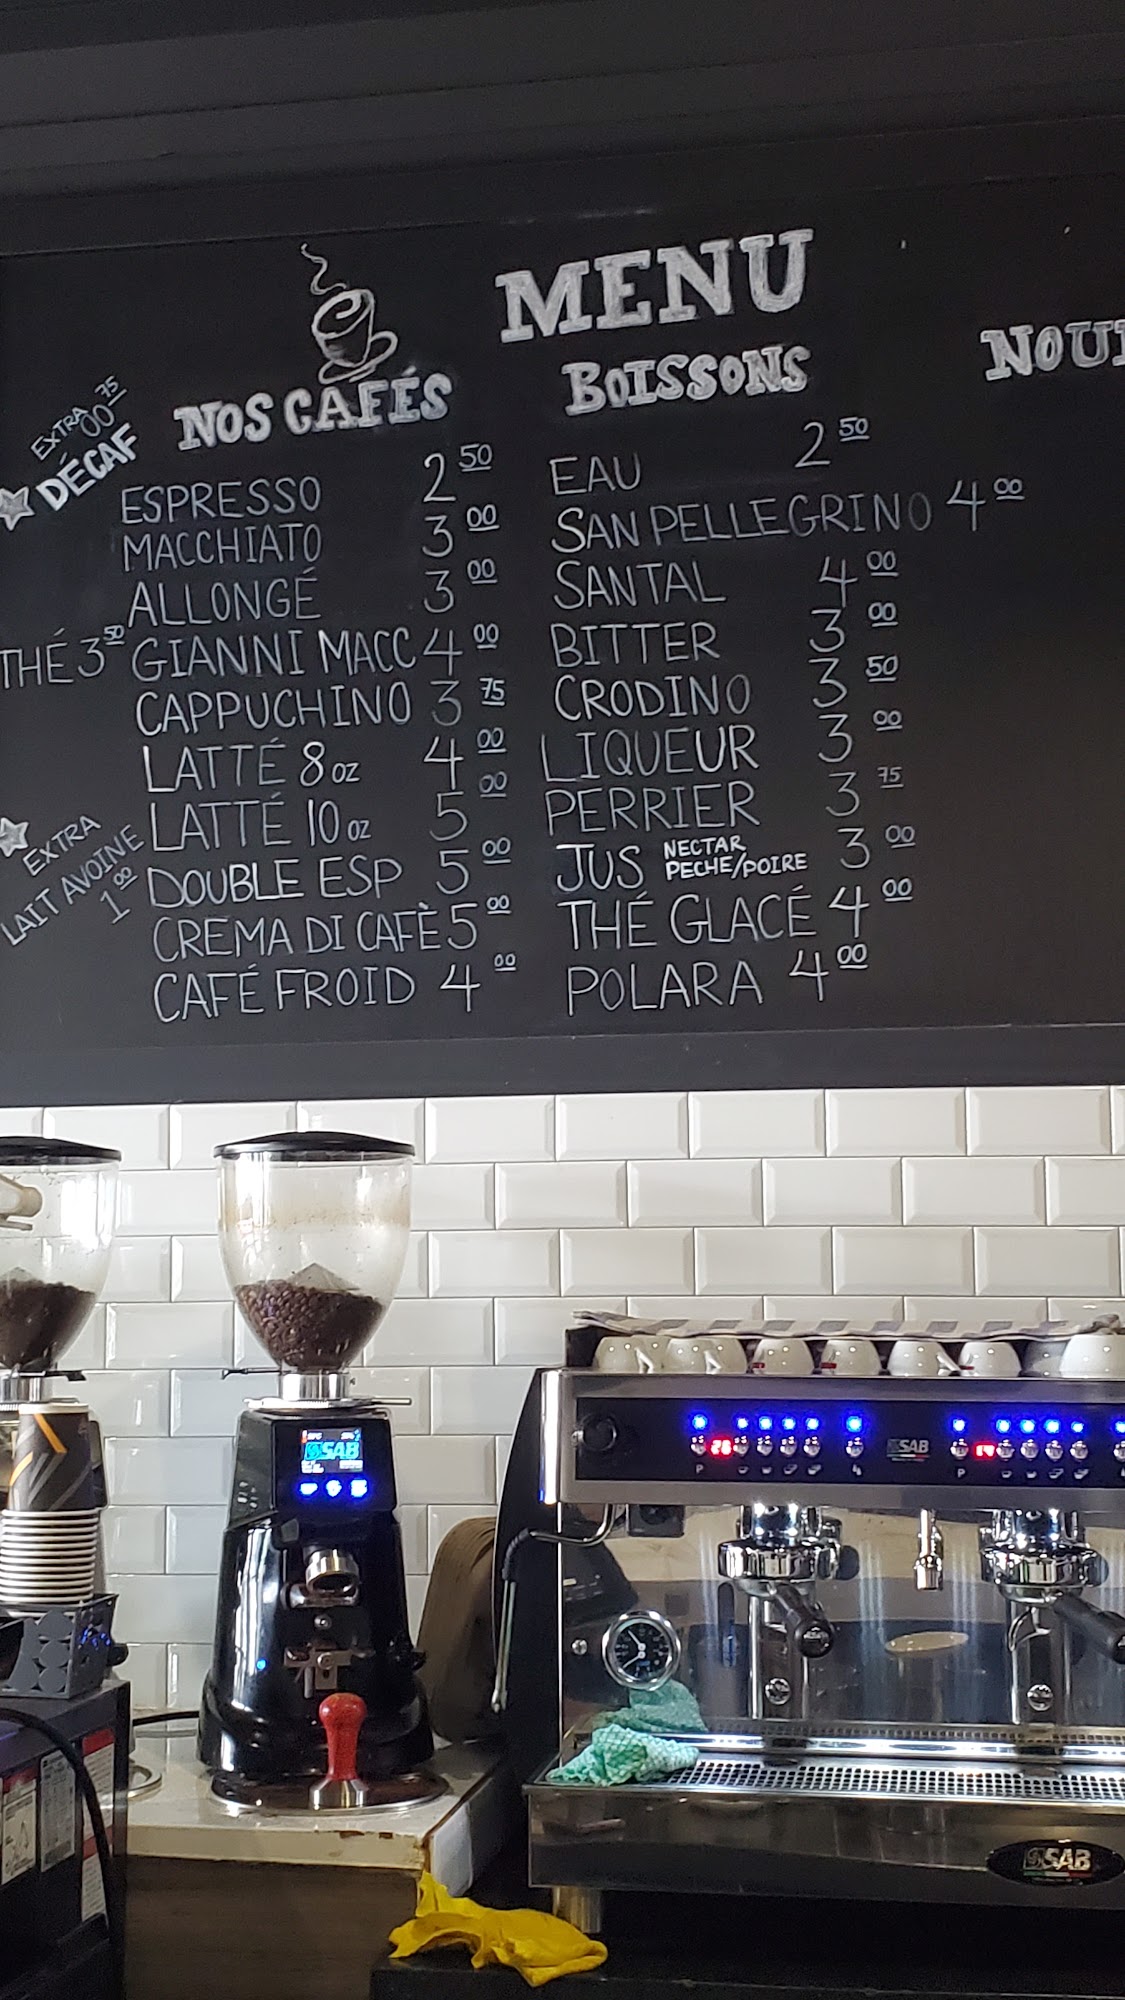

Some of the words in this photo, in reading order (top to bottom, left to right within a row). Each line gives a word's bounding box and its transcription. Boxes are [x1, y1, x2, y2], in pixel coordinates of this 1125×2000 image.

[495, 229, 813, 343] MENU
[174, 393, 273, 450] NOS
[284, 365, 452, 434] CAFÉS
[562, 344, 810, 415] BOISSONS
[31, 407, 85, 460] EXTRA
[94, 376, 119, 397] 75
[36, 422, 137, 511] DÉCAF
[122, 477, 320, 528] ESPRESSO
[424, 453, 456, 502] 2
[459, 444, 492, 467] 50
[550, 457, 640, 494] EAU
[795, 422, 830, 467] 2
[839, 417, 868, 434] 50
[124, 522, 320, 572] MACCHIATO
[423, 515, 452, 557] 3
[467, 505, 496, 526] 00
[552, 508, 639, 552] SAN
[650, 494, 930, 545] PELLEGRINO
[947, 481, 985, 531] 4
[994, 478, 1022, 494] 00
[127, 566, 321, 627] ALLONGÉ
[424, 571, 453, 612] 3
[467, 559, 495, 579] 00
[554, 561, 725, 609] SANTAL
[816, 557, 857, 611] 4
[867, 551, 895, 570] 00
[0, 628, 73, 688] THÉ
[78, 638, 104, 676] 3
[103, 625, 125, 641] 50
[132, 630, 304, 681] GIANNI
[318, 628, 415, 675] MACC
[424, 628, 462, 675] 4
[474, 624, 498, 643] 00
[551, 622, 720, 667] BITTER
[810, 609, 844, 652] 3
[869, 603, 896, 620] 00
[137, 677, 410, 735] CAPPUCHINO
[431, 681, 461, 725] 3
[480, 678, 504, 700] 75
[555, 675, 749, 720] CRODINO
[809, 658, 847, 707] 3
[866, 656, 898, 676] 50
[143, 734, 285, 796] LATTÉ
[300, 741, 324, 786] 8
[424, 737, 463, 790] 4
[478, 728, 503, 748] 00
[542, 725, 759, 786] LIQUEUR
[819, 714, 852, 762] 3
[874, 710, 901, 725] 00
[148, 789, 291, 851] LATTÉ
[308, 800, 339, 846] 10
[430, 792, 467, 840] 5
[480, 772, 507, 792] 00
[545, 780, 759, 835] PERRIER
[826, 772, 859, 816] 3
[878, 767, 901, 782] 75
[23, 815, 101, 876] EXTRA
[113, 866, 132, 886] 00
[148, 859, 304, 908] DOUBLE
[320, 855, 402, 898] ESP
[437, 850, 468, 894] 5
[483, 837, 510, 856] 00
[556, 844, 647, 895] JUS
[664, 835, 746, 858] NECTAR
[838, 828, 869, 868] 3
[886, 826, 914, 842] 00
[664, 851, 807, 880] PECHE/POIRE
[0, 888, 59, 946] LAIT
[61, 824, 145, 905] AVOINE
[558, 890, 657, 949] THÉ
[671, 885, 816, 943] GLACÉ
[829, 886, 869, 937] 4
[883, 878, 912, 896] 00
[154, 917, 293, 962] CREMA
[306, 915, 345, 953] DI
[448, 903, 477, 949] 5
[487, 895, 509, 911] 00
[154, 960, 263, 1022] CAFÉ
[276, 967, 414, 1009] FROID
[440, 965, 480, 1012] 4
[495, 954, 515, 966] 00
[568, 961, 762, 1015] POLARA
[789, 950, 829, 1001] 4
[837, 944, 867, 964] 00
